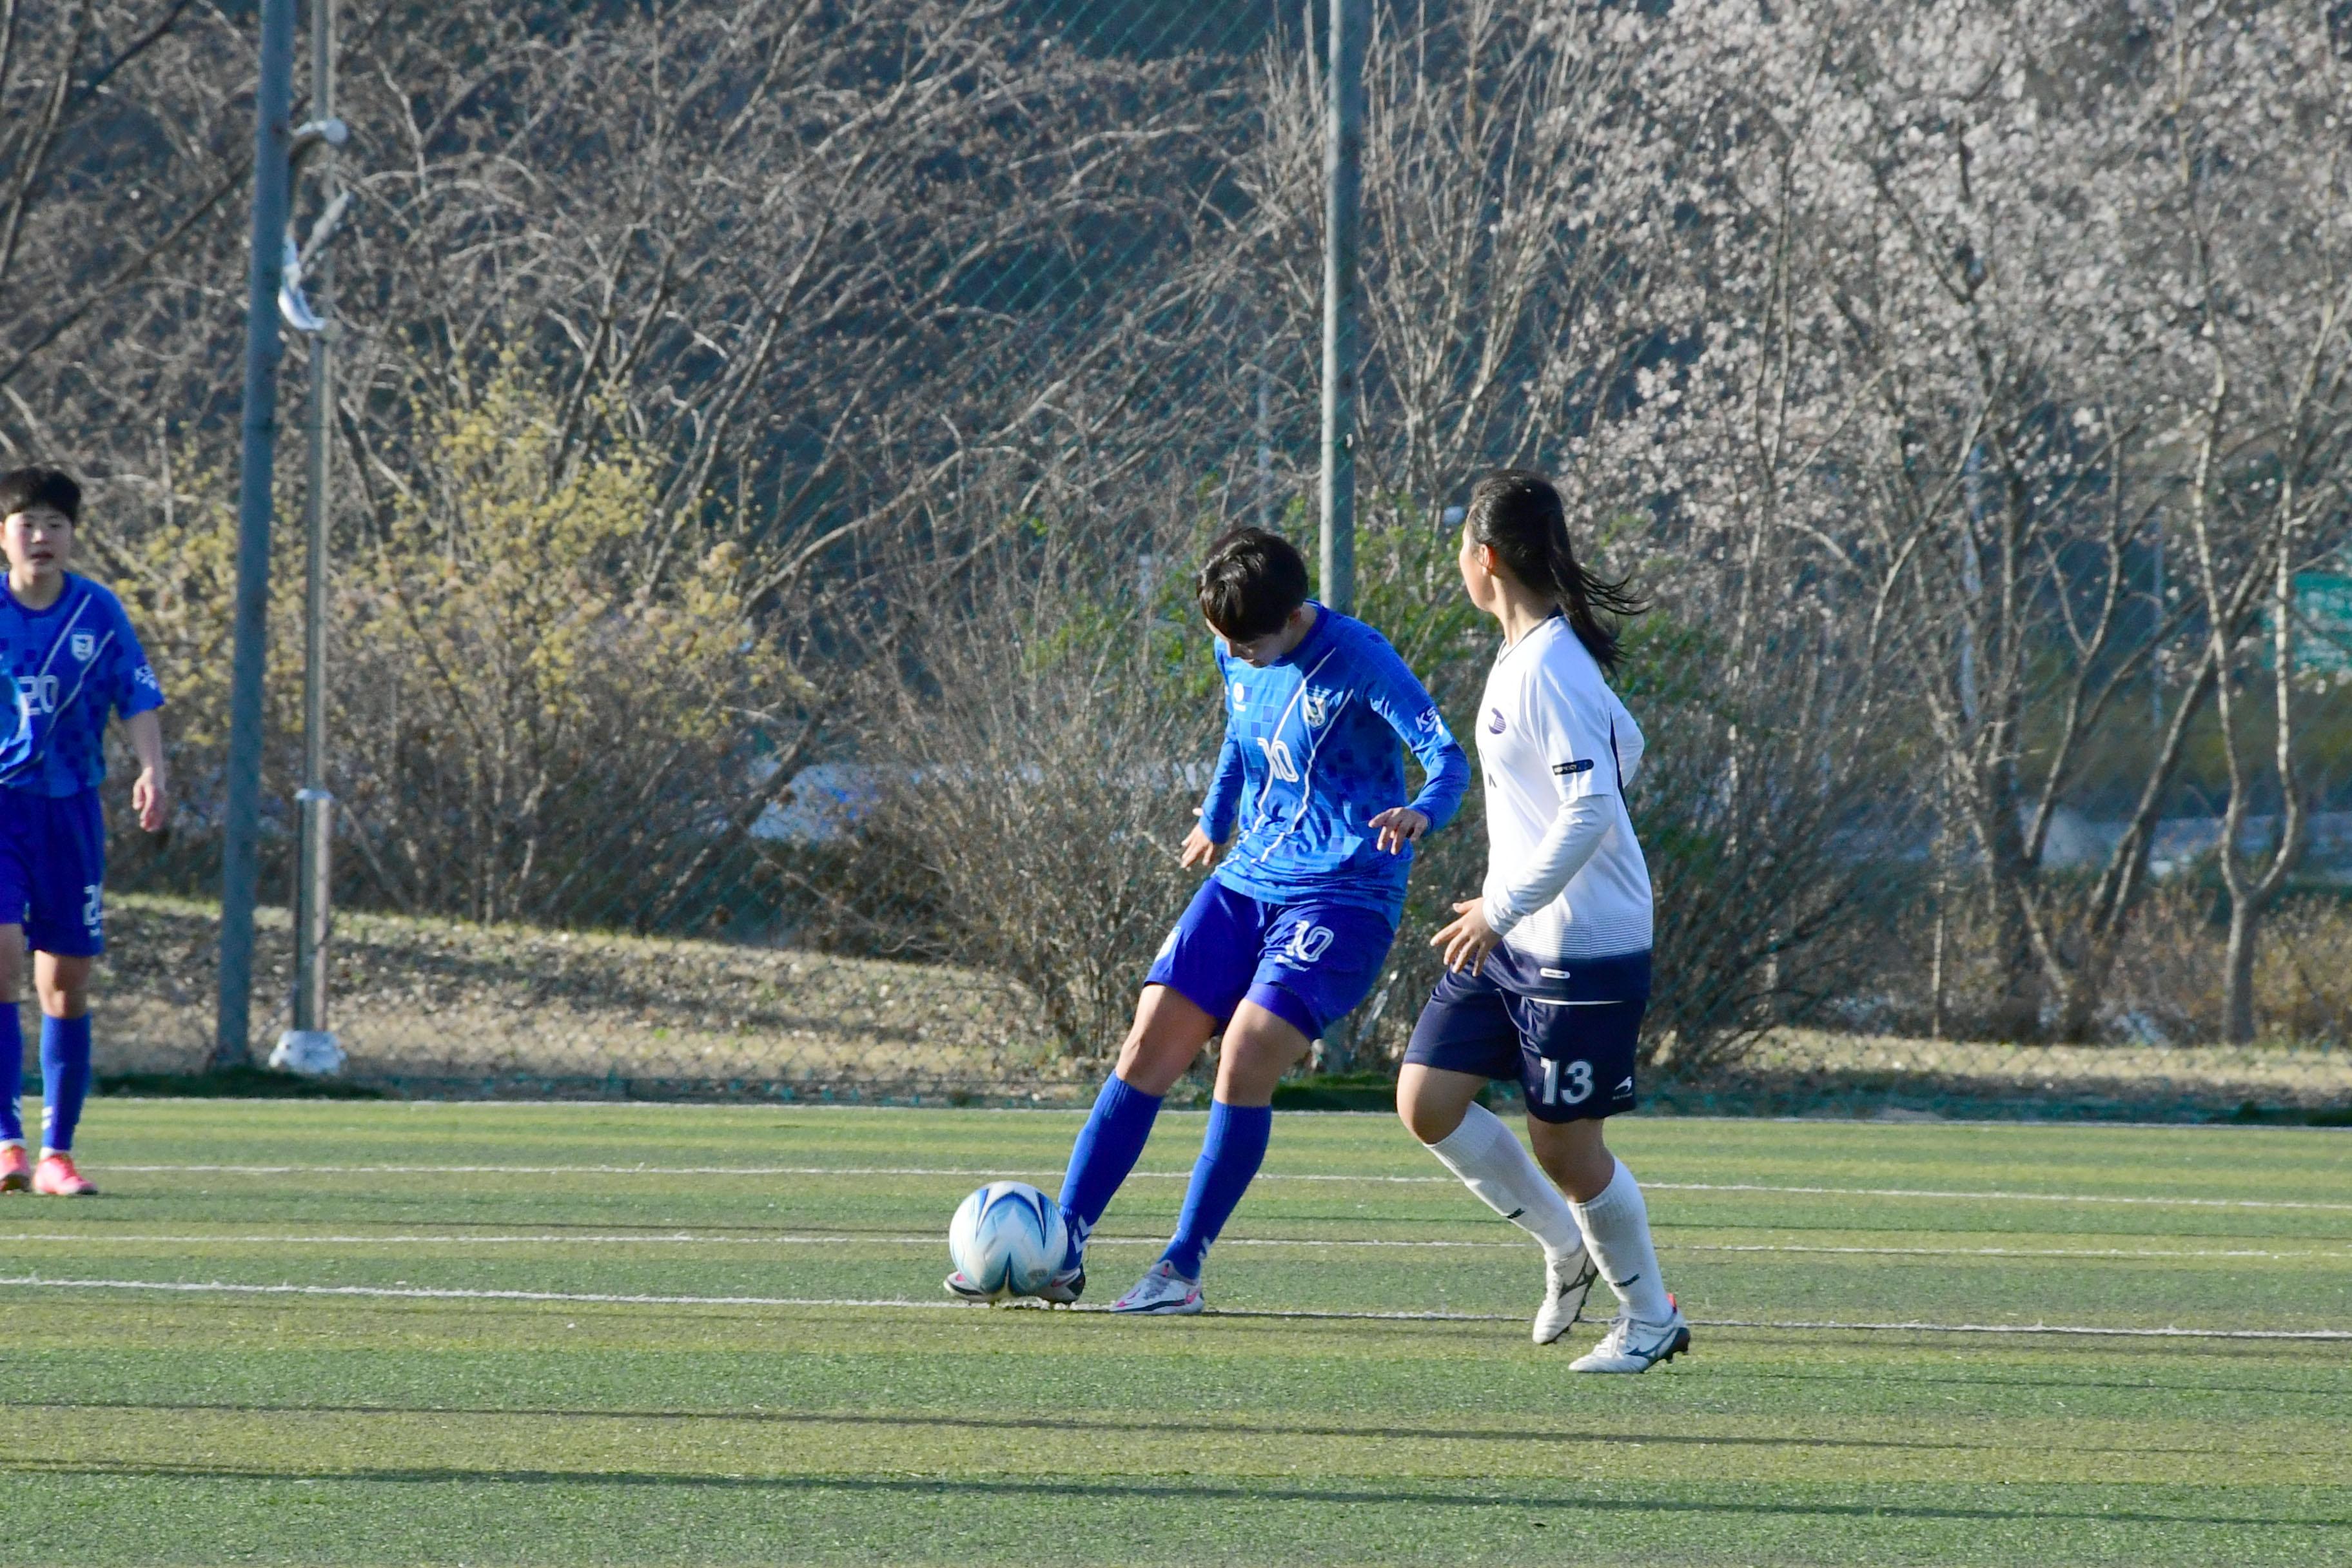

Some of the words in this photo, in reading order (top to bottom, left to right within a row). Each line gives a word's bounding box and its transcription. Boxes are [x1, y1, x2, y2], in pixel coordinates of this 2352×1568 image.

[18, 674, 59, 715] 20
[1257, 737, 1299, 783] 10
[1286, 919, 1334, 962] 10
[1540, 1057, 1594, 1105] 13
